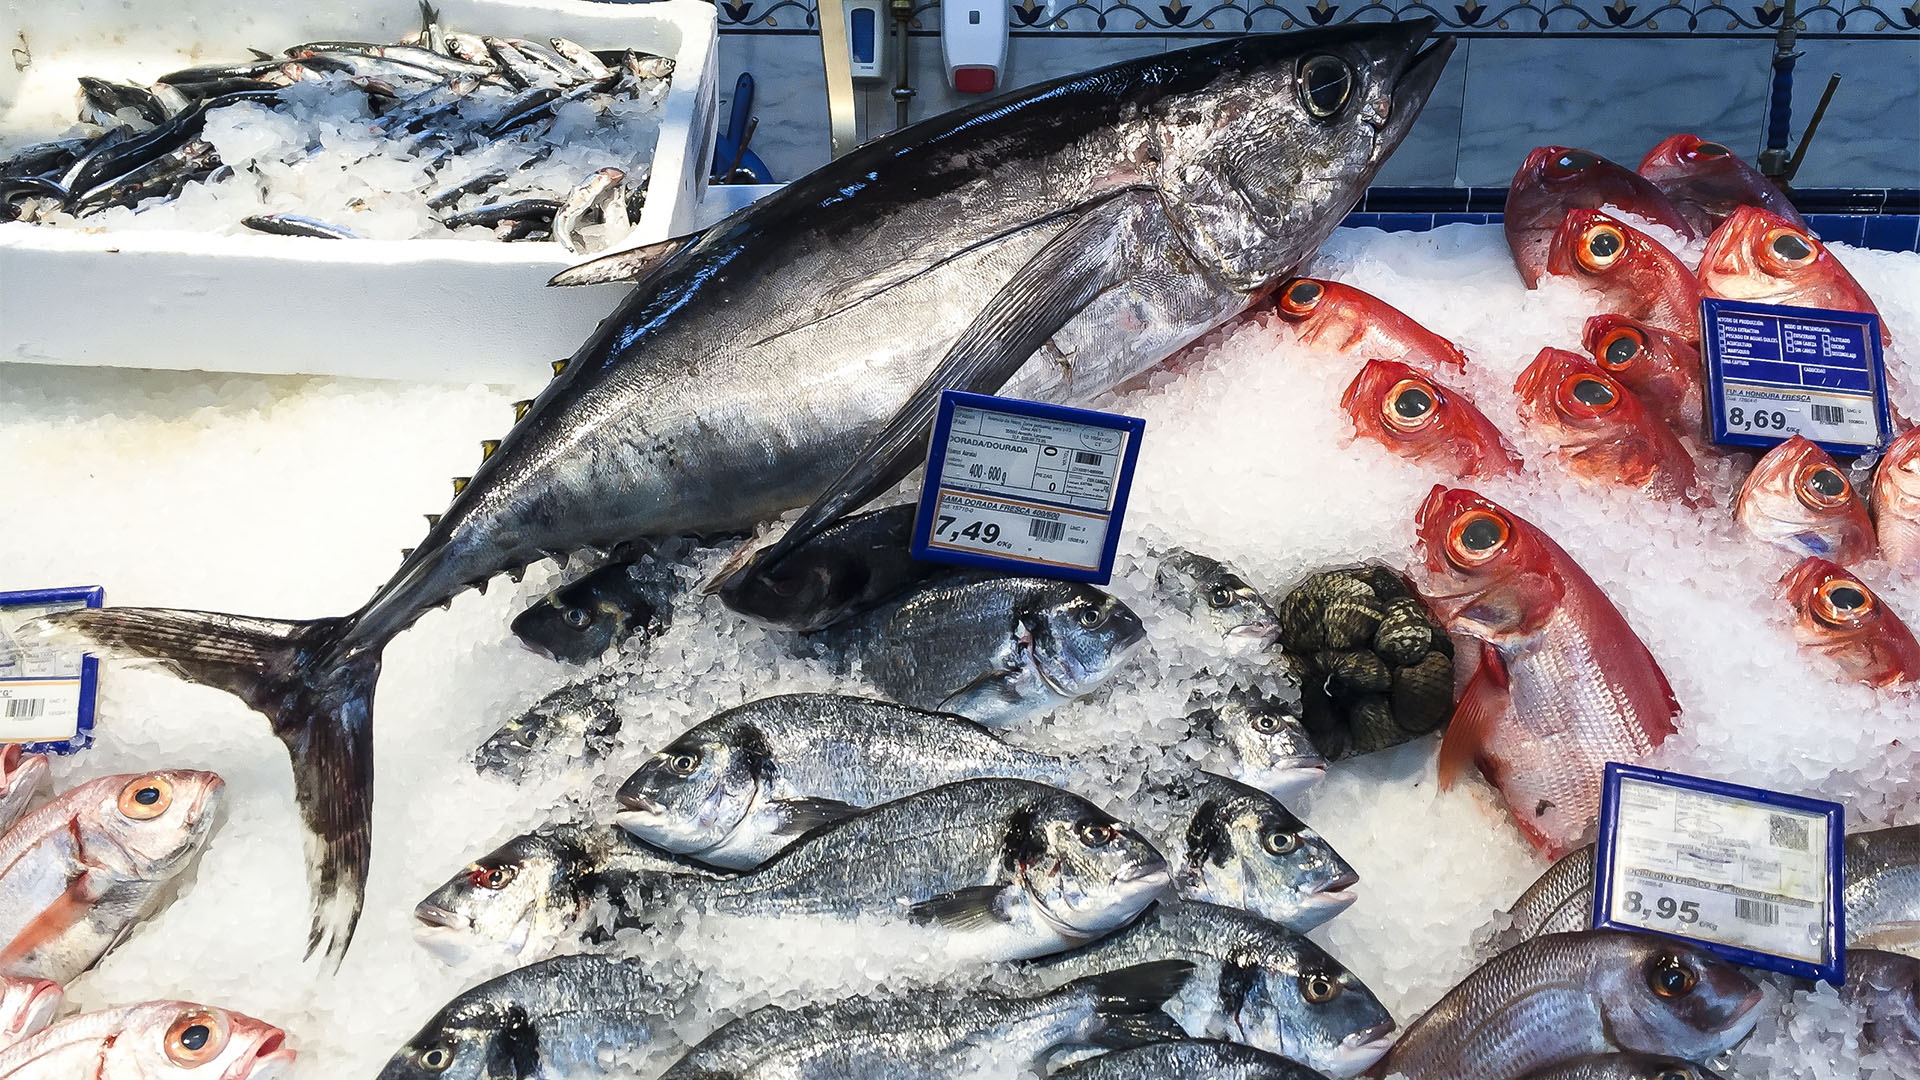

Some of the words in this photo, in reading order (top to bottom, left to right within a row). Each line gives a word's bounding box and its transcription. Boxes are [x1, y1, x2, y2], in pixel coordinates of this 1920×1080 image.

[1781, 394, 1811, 402] FRESCA
[1729, 407, 1786, 431] 8,69
[969, 463, 984, 478] 400
[988, 466, 1002, 481] 600
[1049, 482, 1056, 491] 0
[964, 498, 998, 510] DORADA
[999, 503, 1030, 514] FRESCA
[936, 515, 1001, 544] 7,49
[1622, 891, 1700, 924] 8,95
